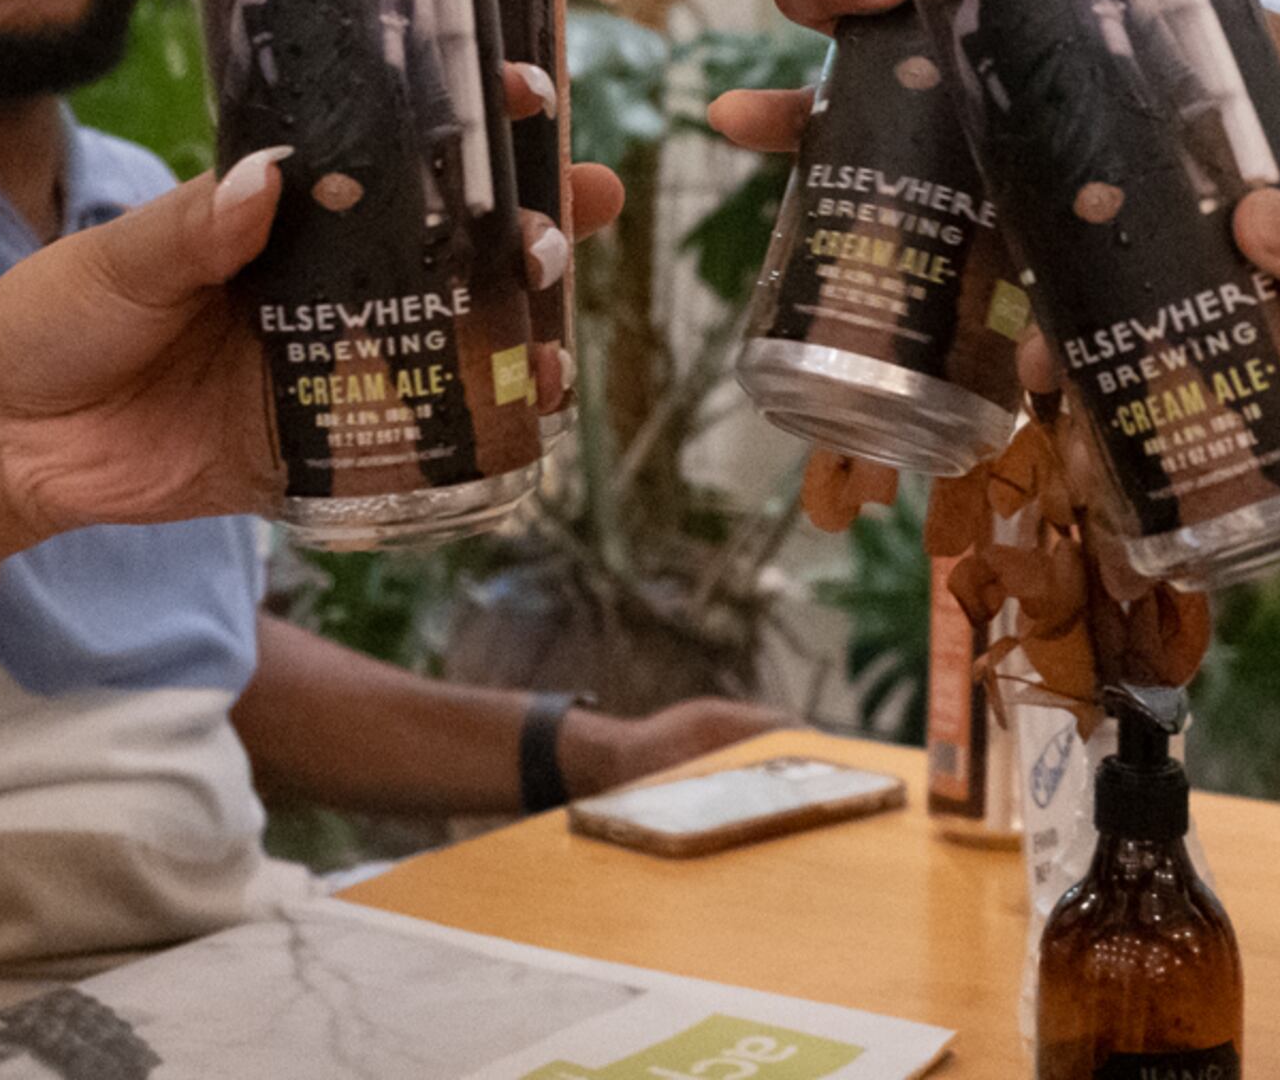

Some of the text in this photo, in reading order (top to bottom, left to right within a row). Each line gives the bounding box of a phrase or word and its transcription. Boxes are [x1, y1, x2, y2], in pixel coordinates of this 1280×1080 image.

[807, 164, 997, 229] ELSEWHERE
[819, 198, 963, 246] BREWING
[260, 288, 470, 331] ELSEWHERE
[1065, 272, 1277, 369] ELSEWHERE
[287, 331, 447, 362] BREWING
[1097, 322, 1257, 394] BREWING
[298, 365, 446, 406] CREAM ALE
[1116, 358, 1270, 437] CREAM ALE
